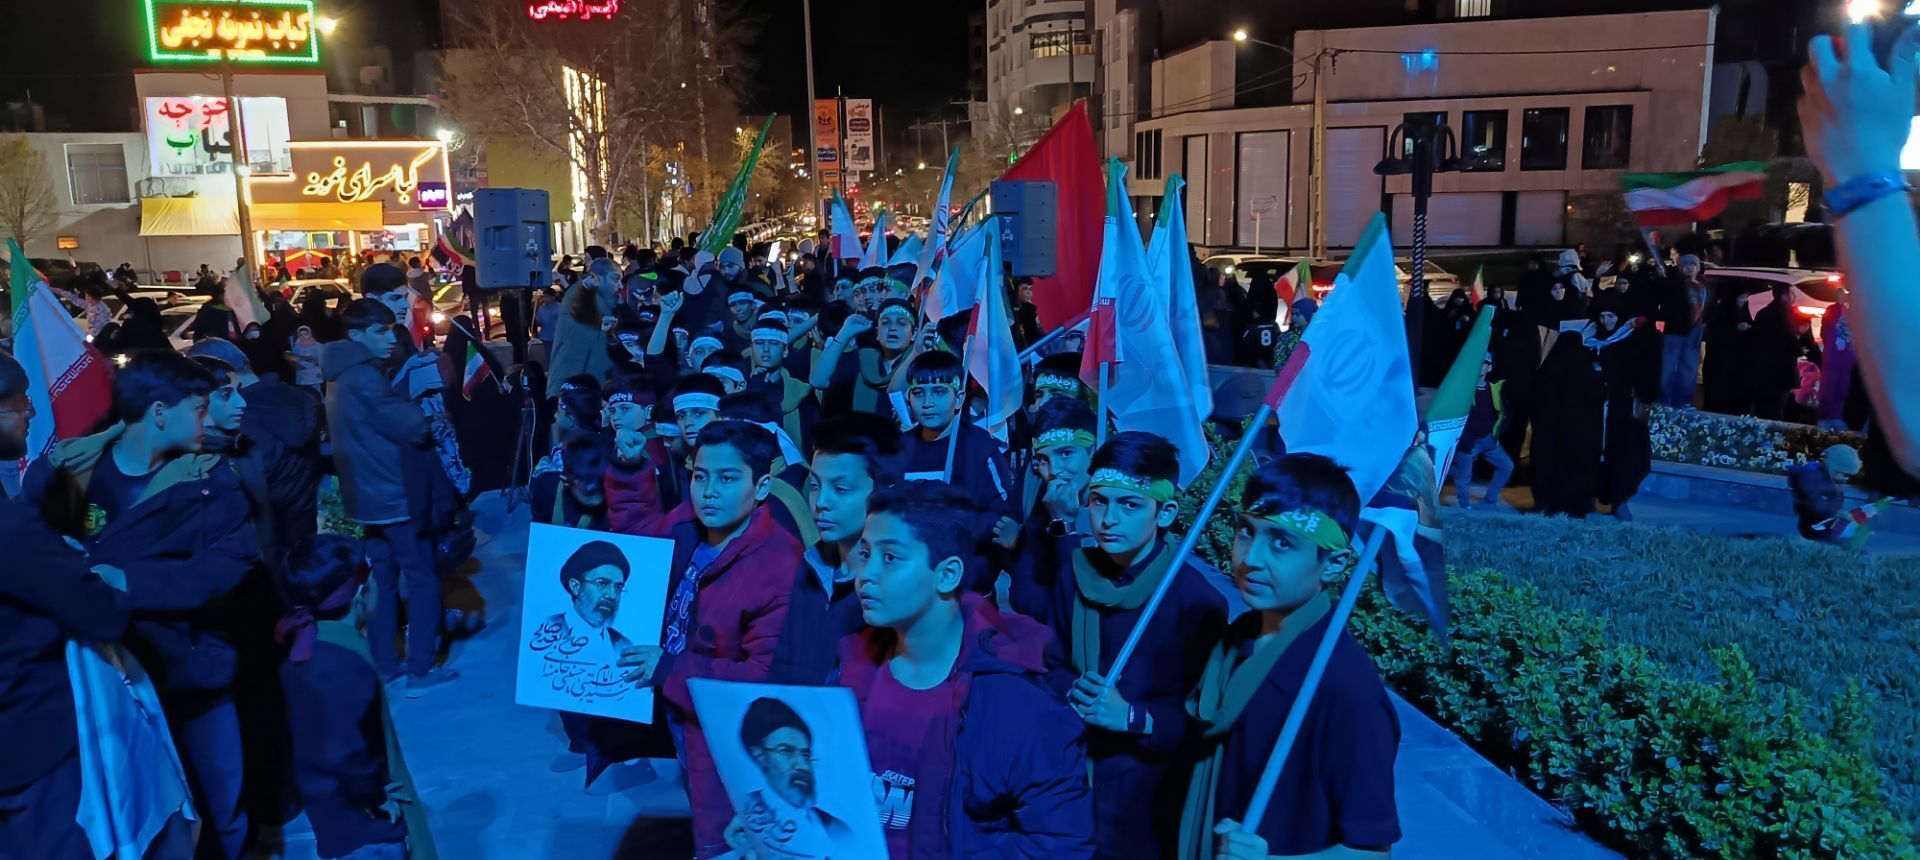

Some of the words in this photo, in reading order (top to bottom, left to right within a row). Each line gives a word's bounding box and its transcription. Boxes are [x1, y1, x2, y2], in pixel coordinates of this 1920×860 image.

[161, 9, 213, 47] نجفی
[217, 11, 264, 48] نمونه
[266, 11, 313, 49] کباب
[302, 156, 347, 196] نمونه
[1261, 329, 1272, 346] 8
